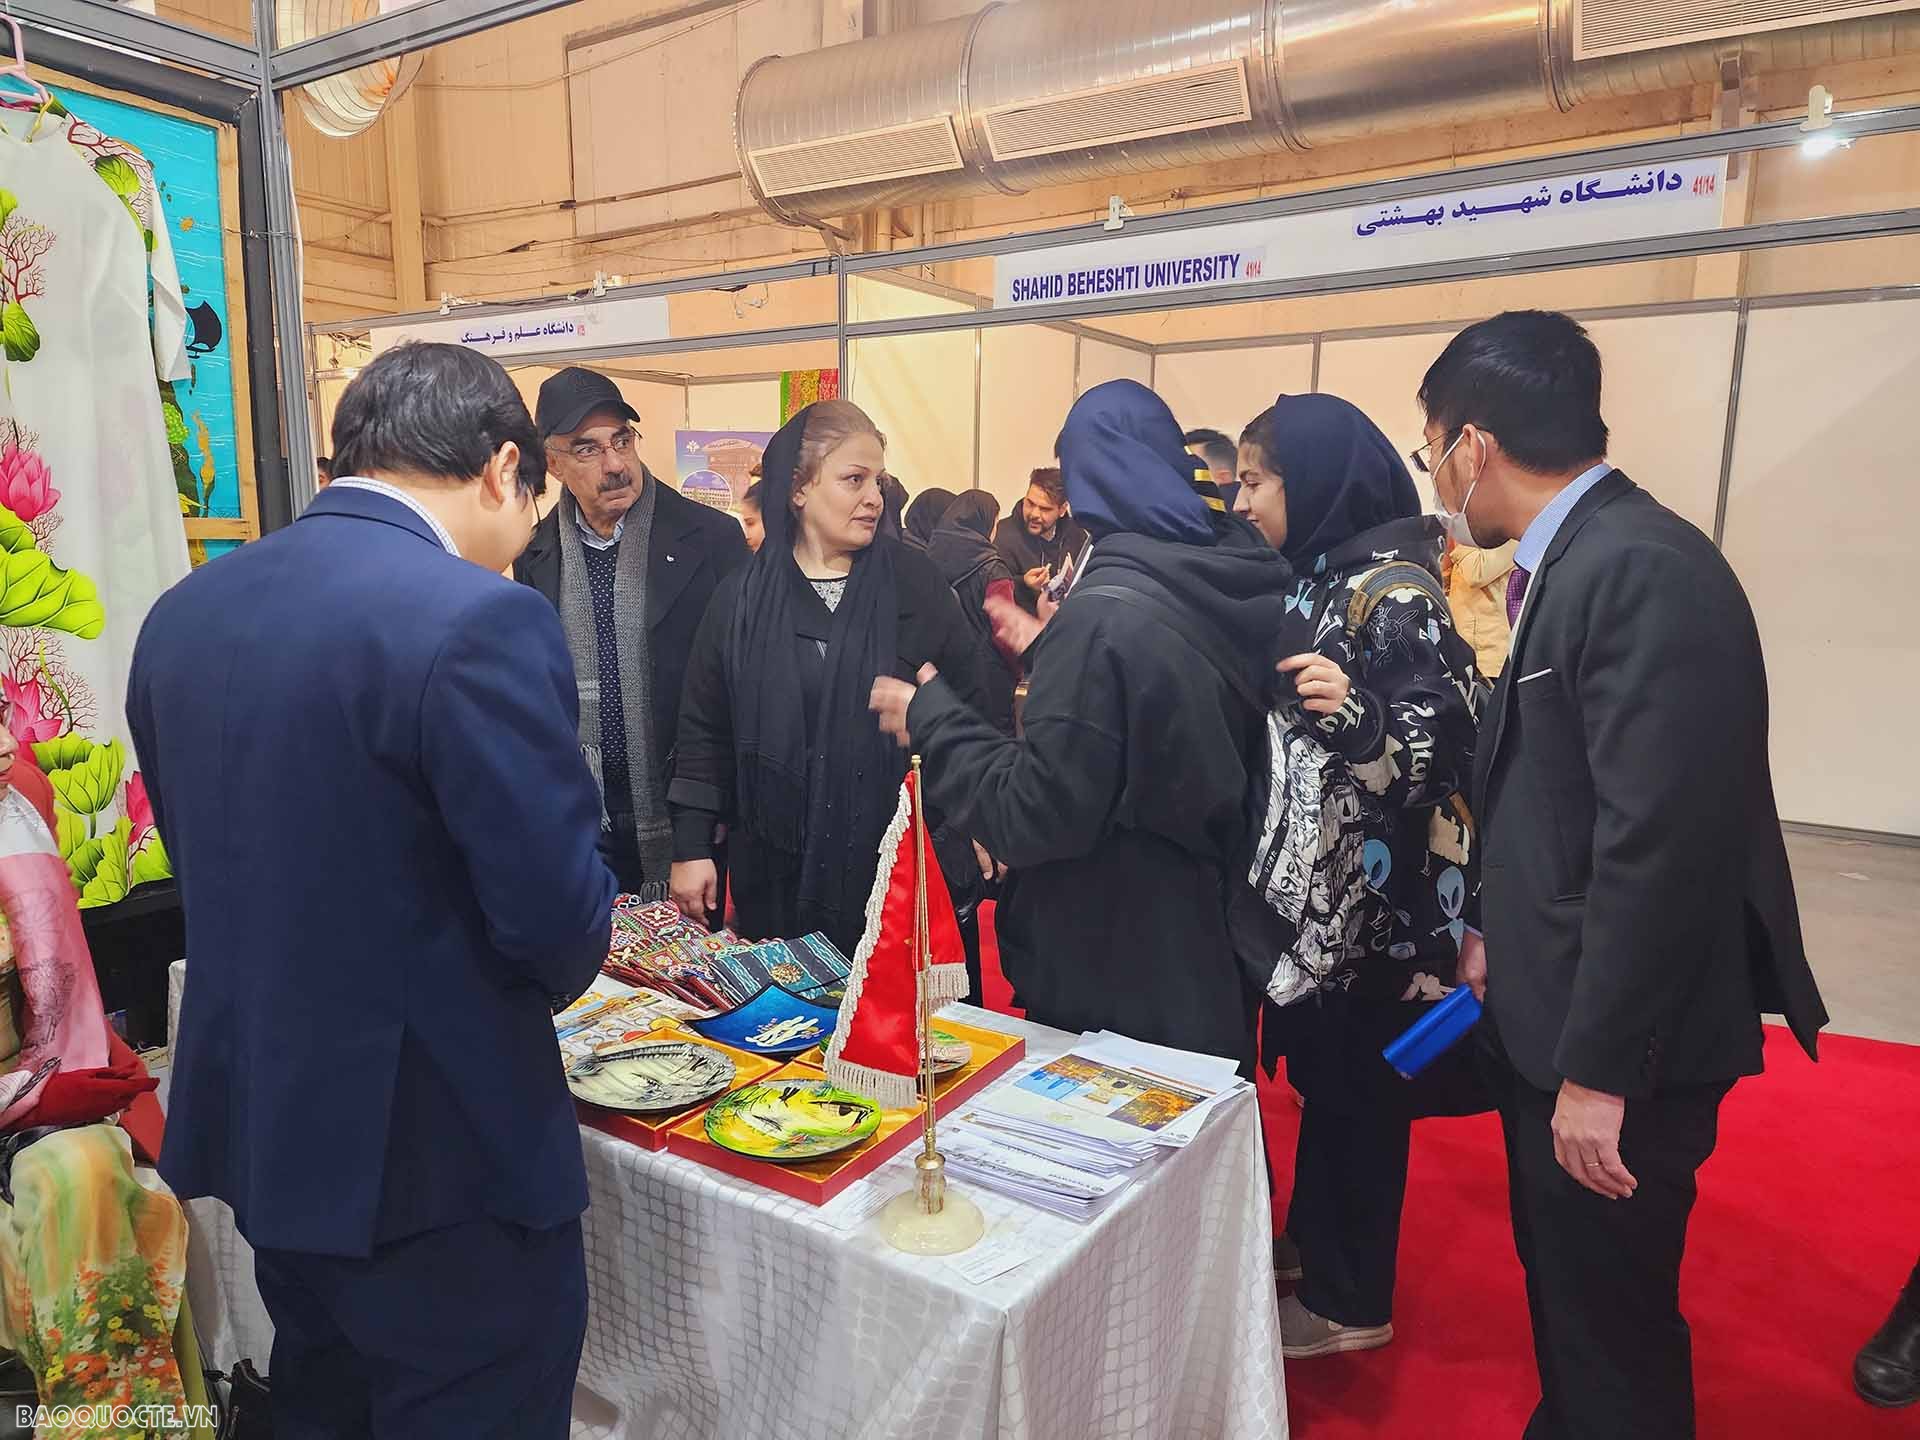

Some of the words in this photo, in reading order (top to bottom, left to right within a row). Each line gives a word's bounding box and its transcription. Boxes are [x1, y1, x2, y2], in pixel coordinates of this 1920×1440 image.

[1451, 186, 1552, 222] شهید
[1559, 168, 1683, 205] دانشگاه
[1356, 204, 1445, 237] بهشتی
[1012, 274, 1063, 302] SHAHID
[1067, 265, 1139, 296] BEHESHTI
[1144, 253, 1240, 288] UNIVERSITY
